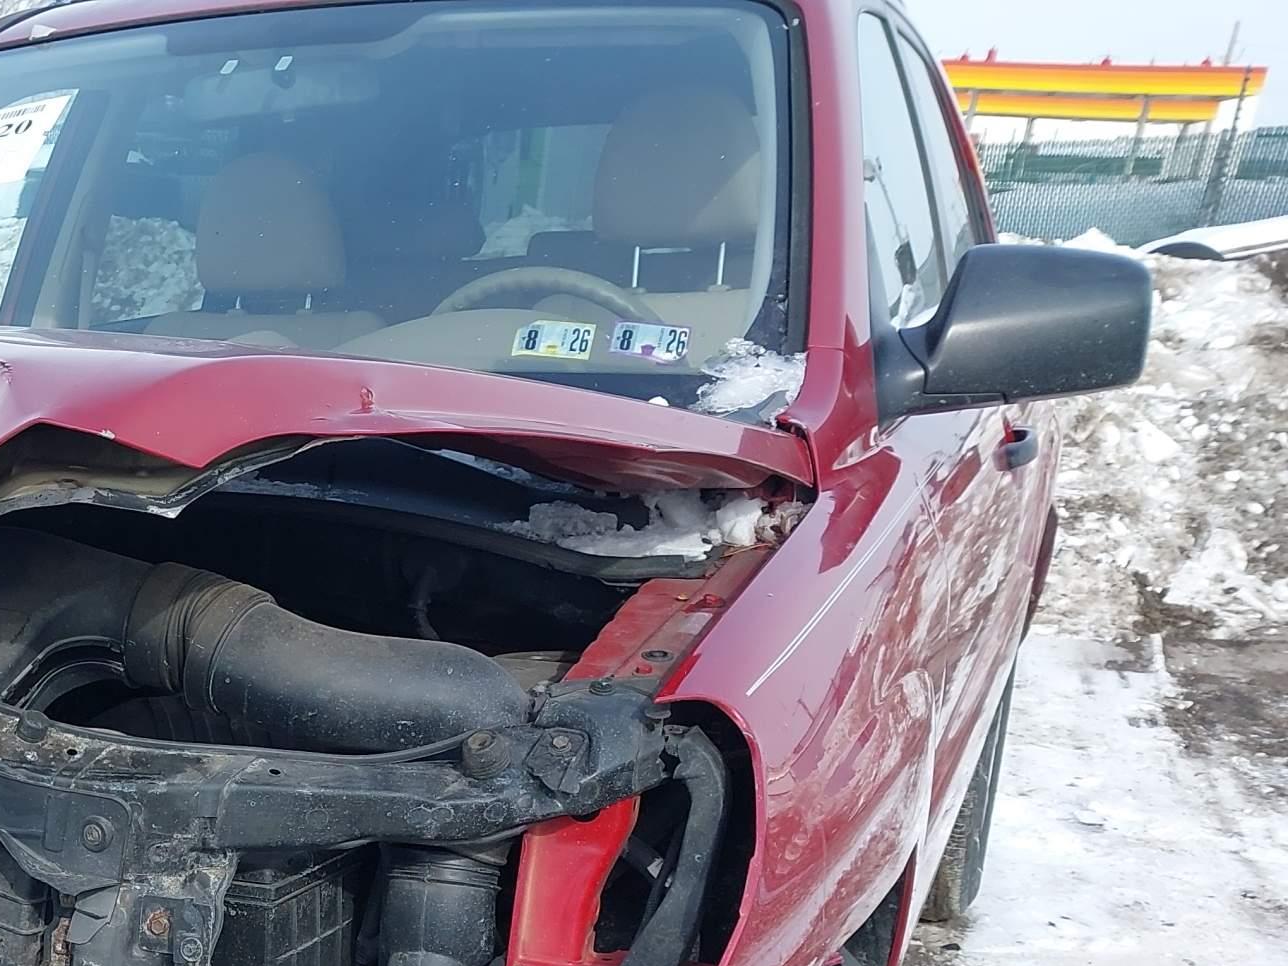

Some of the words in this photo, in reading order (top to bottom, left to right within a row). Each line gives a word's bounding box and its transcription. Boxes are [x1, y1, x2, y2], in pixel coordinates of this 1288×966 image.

[524, 329, 539, 351] 8
[568, 327, 591, 353] 26
[619, 329, 634, 351] 8
[664, 328, 688, 357] 26
